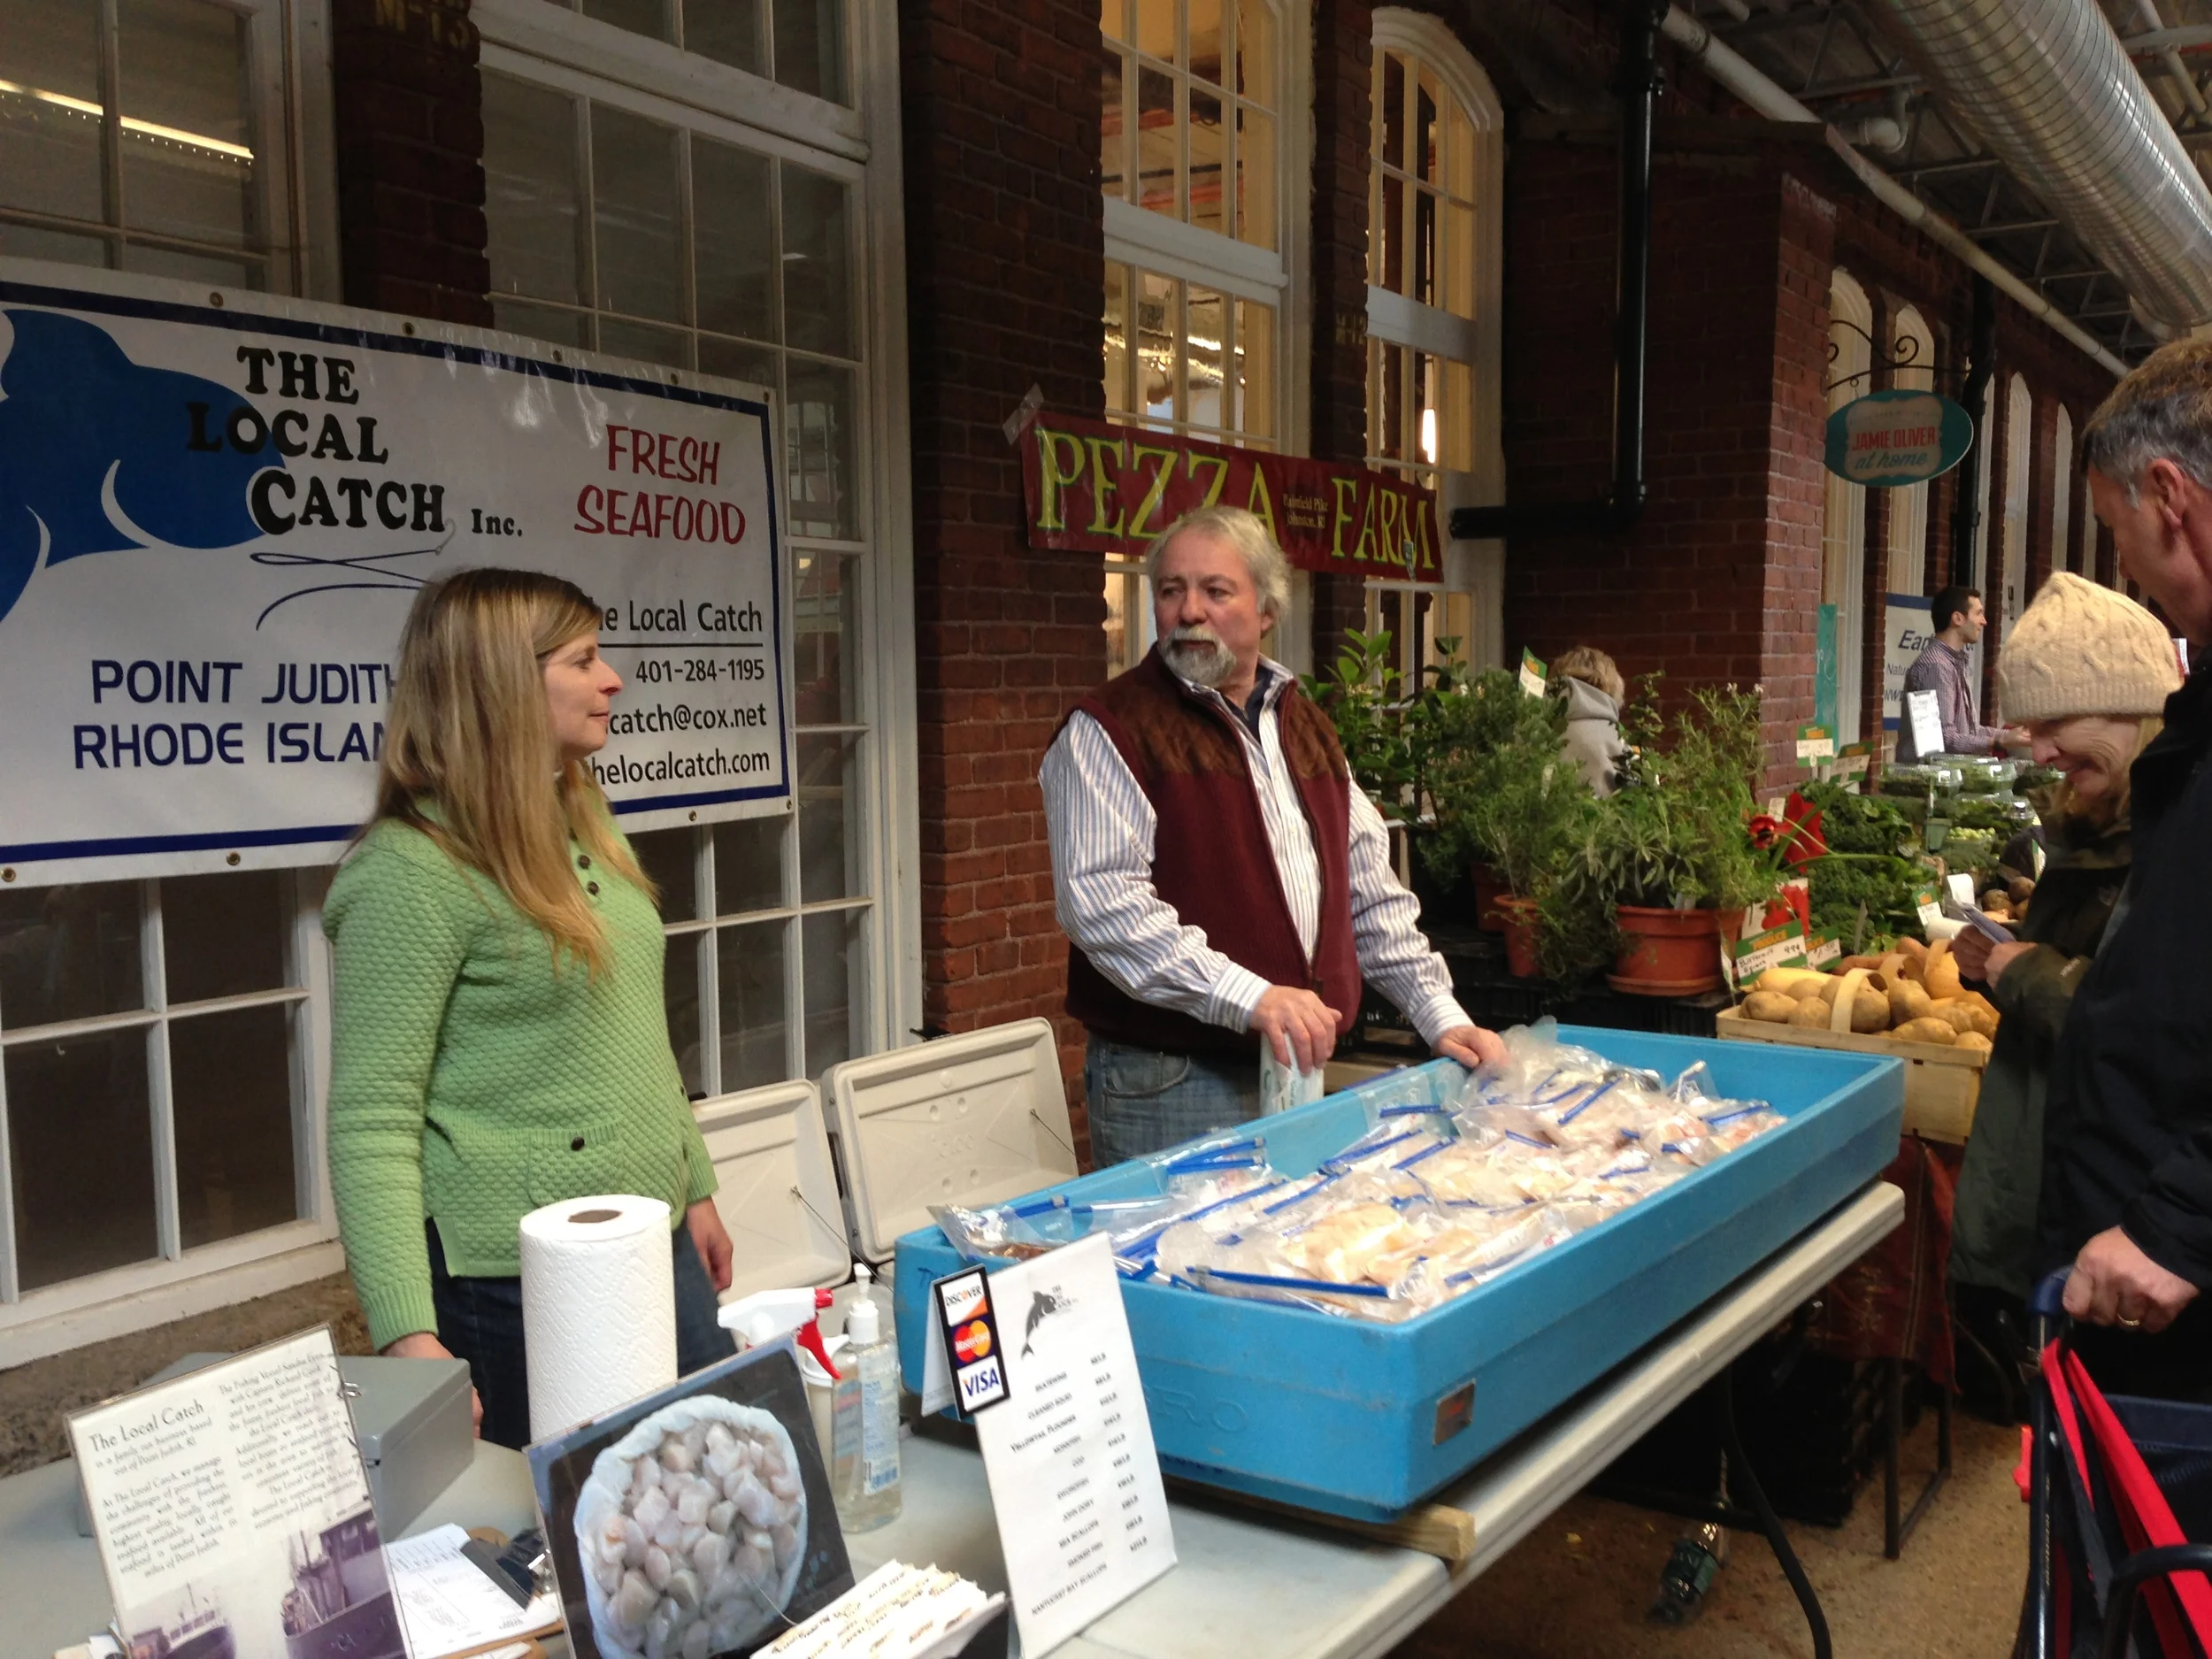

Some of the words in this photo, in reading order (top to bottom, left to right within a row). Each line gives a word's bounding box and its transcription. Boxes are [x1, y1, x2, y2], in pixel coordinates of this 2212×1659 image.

[236, 346, 359, 404] THE
[186, 402, 388, 464] LOCAL
[1851, 430, 1891, 451] JAMIE
[1893, 426, 1936, 448] OLIVER
[606, 425, 720, 486] FRESH
[1855, 451, 1876, 470] at
[1878, 452, 1929, 469] home
[251, 469, 445, 535] CATCH
[471, 508, 523, 537] Inc.
[574, 484, 746, 545] SEAFOOD
[1034, 426, 1279, 541] PEZZA
[1331, 477, 1435, 569] FARM
[629, 599, 687, 632] Local
[697, 601, 762, 632] Catch
[91, 660, 243, 703] POINT
[635, 658, 764, 684] 401-284-1195
[606, 703, 767, 735] catch@cox.net
[73, 722, 244, 768] RHODE
[267, 722, 386, 763] ISLA
[591, 749, 770, 786] helocalcatch.com
[944, 1285, 982, 1308] DISCOVER
[963, 1368, 1000, 1398] VISA
[88, 1433, 119, 1452] The
[119, 1414, 159, 1442] Local
[161, 1399, 204, 1426] Catch
